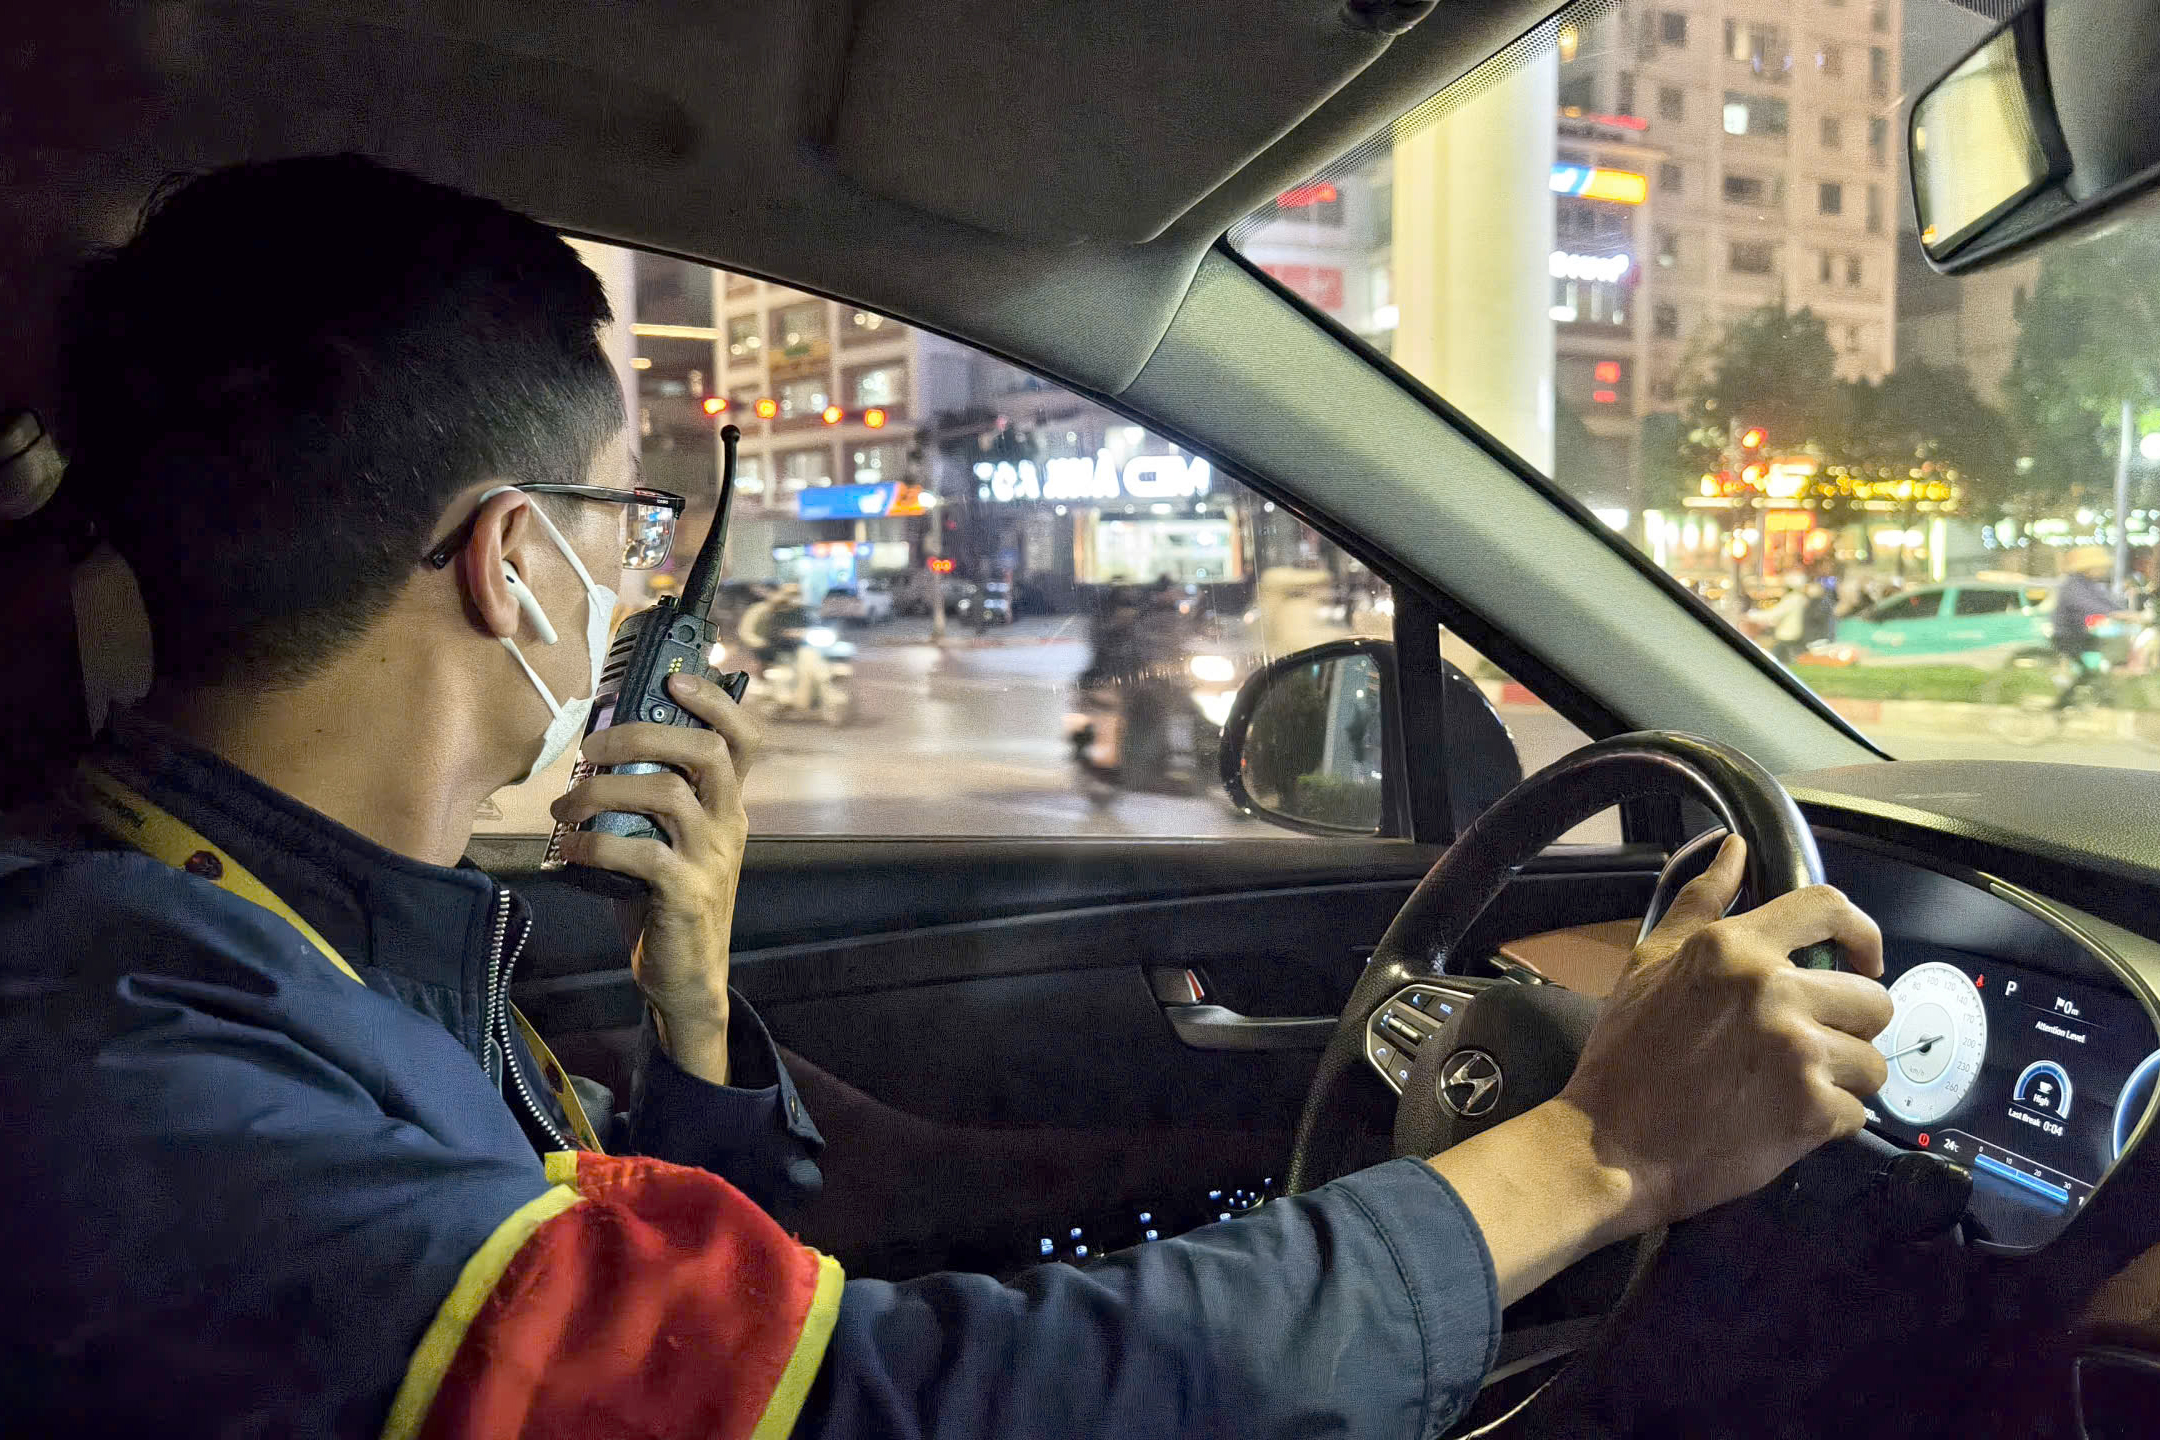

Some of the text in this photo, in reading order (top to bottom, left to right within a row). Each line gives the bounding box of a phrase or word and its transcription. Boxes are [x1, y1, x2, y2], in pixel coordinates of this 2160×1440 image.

[1927, 975, 1939, 986] 100
[1944, 981, 1957, 992] 120
[2005, 980, 2018, 996] P
[2035, 1020, 2086, 1044] Attention Level
[1962, 1036, 1976, 1049] 200
[1956, 1060, 1971, 1073] 230
[1944, 1080, 1959, 1093] 260
[2033, 1092, 2050, 1107] High
[2007, 1107, 2064, 1137] Last Break 0:04
[2005, 1157, 2013, 1165] 10
[2033, 1168, 2042, 1178] 20
[2063, 1181, 2072, 1190] 30
